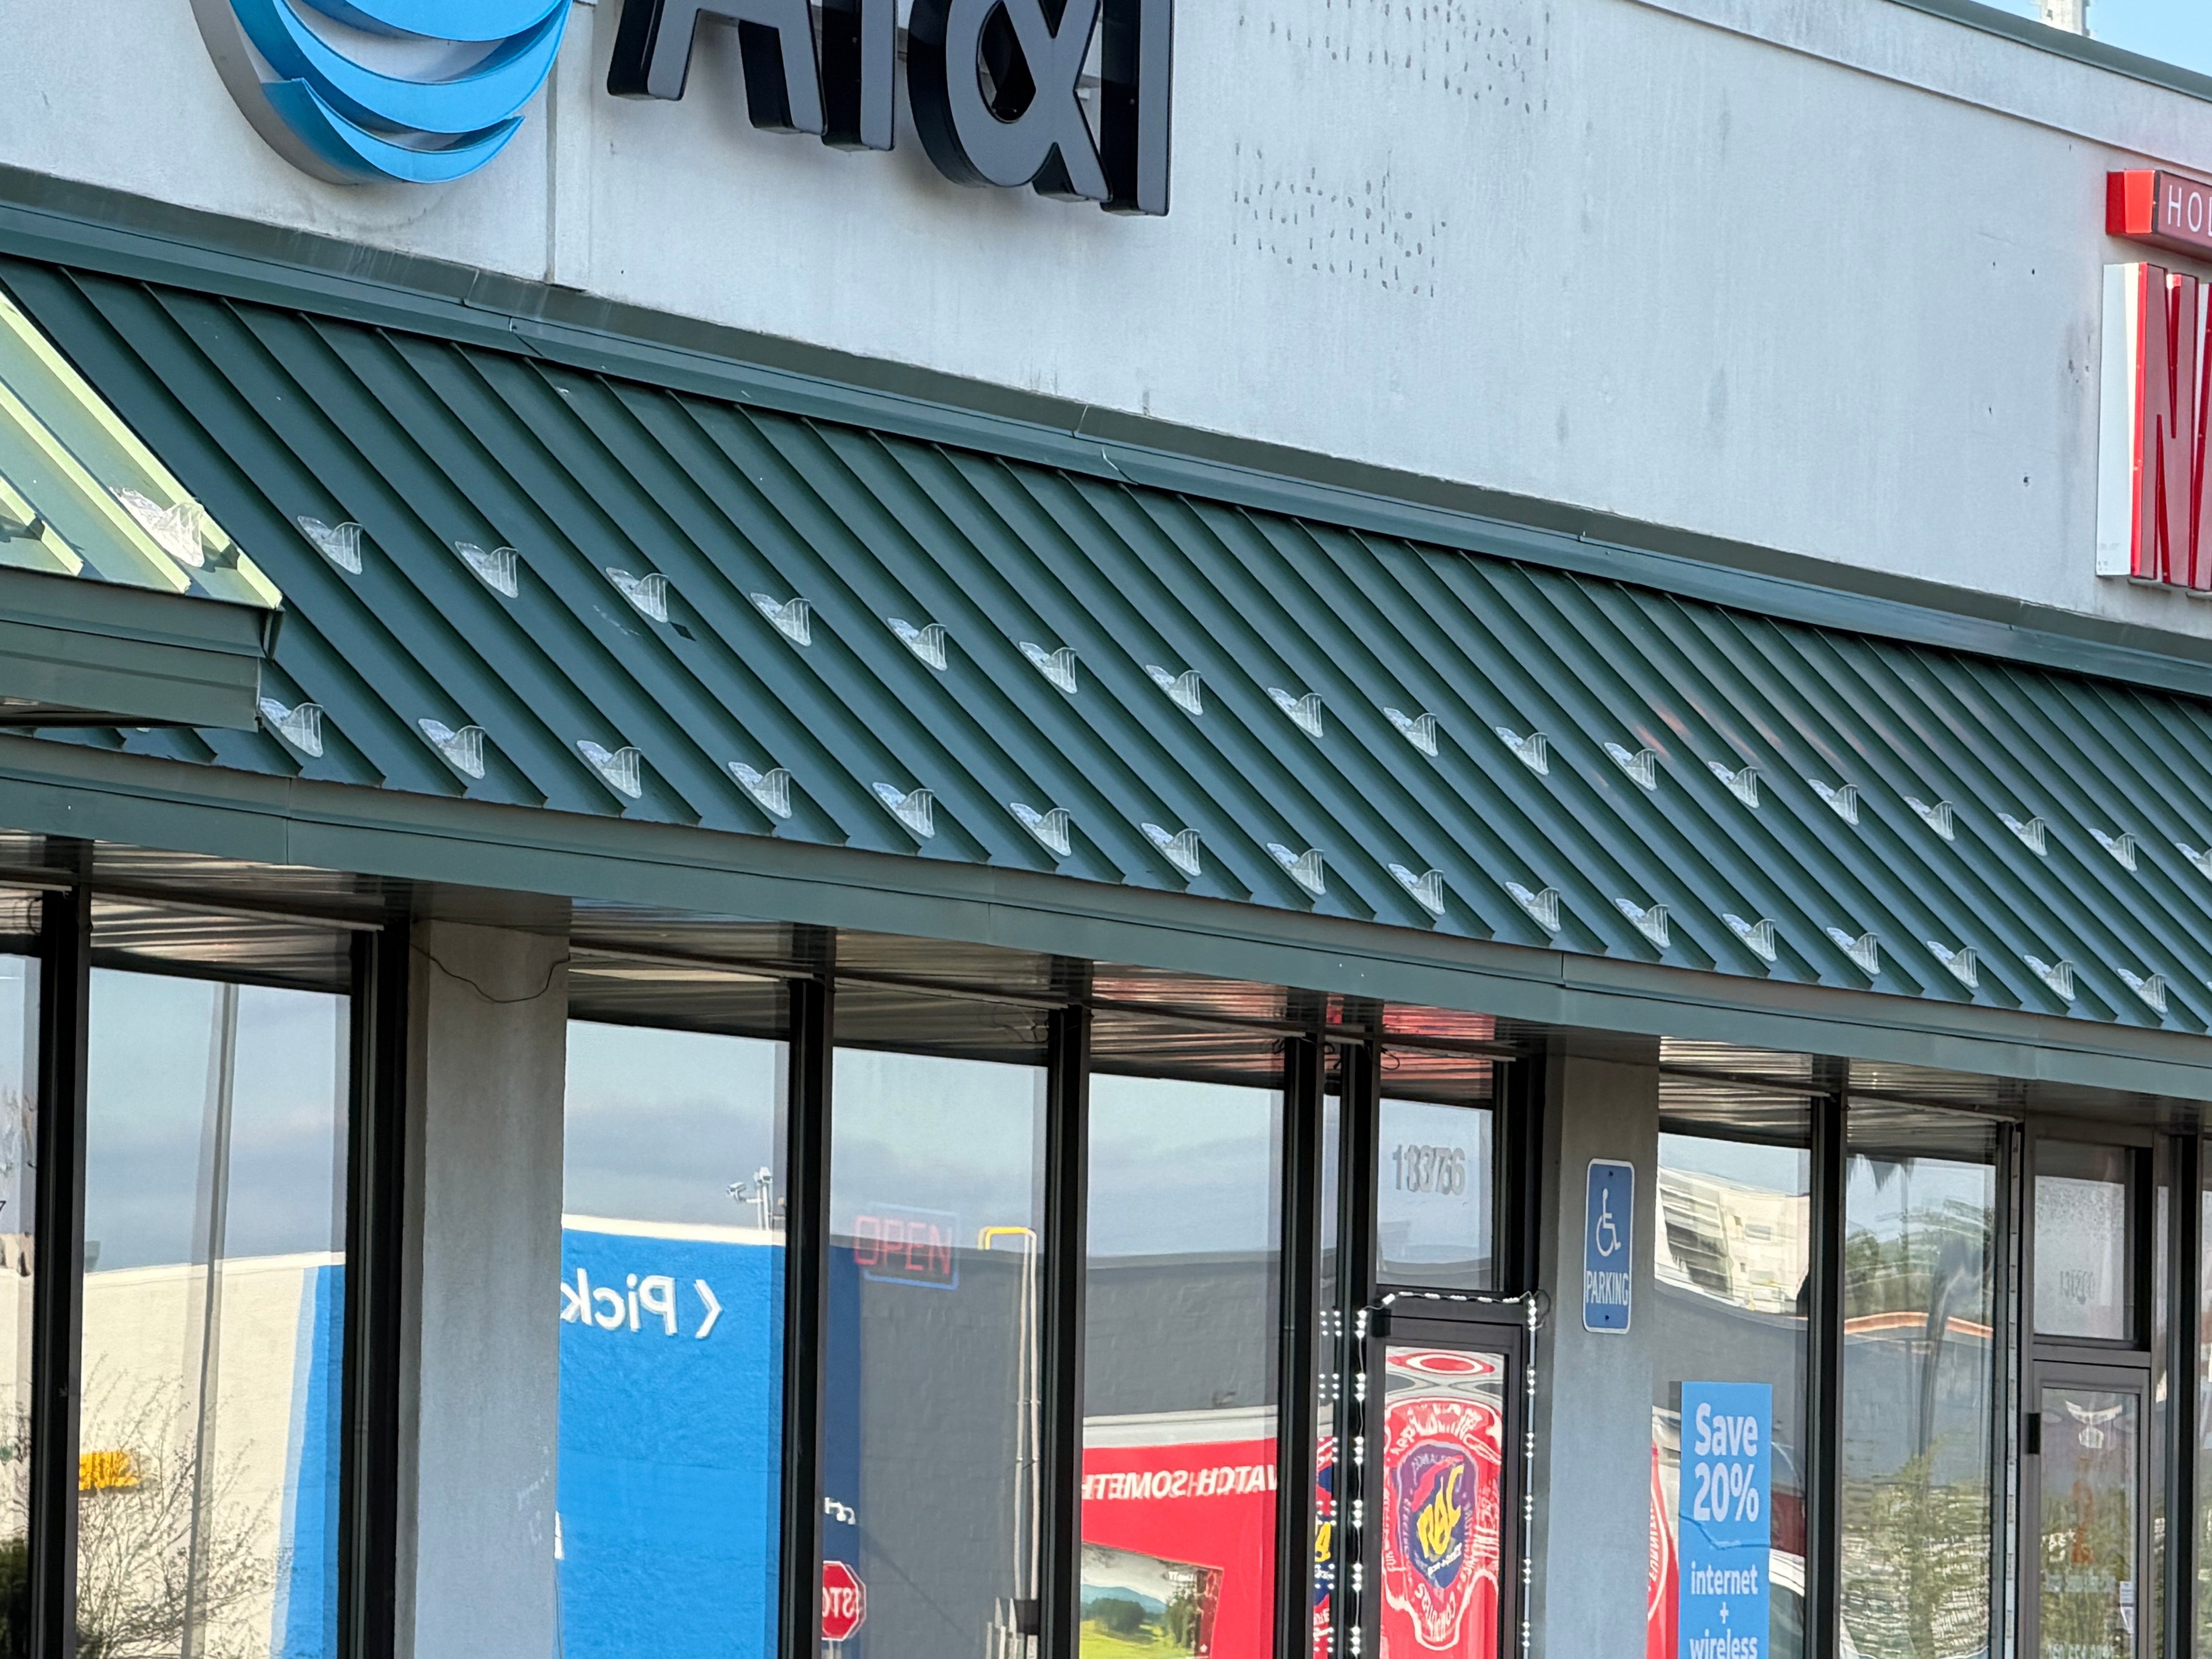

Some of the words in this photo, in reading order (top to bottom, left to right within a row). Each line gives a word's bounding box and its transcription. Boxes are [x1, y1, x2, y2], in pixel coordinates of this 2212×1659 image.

[2126, 262, 2212, 589] N
[854, 1215, 953, 1275] OPEN
[1586, 1271, 1628, 1305] PARKING
[1694, 1402, 1758, 1457] Save
[1693, 1462, 1759, 1522] 20%
[1691, 1561, 1758, 1595] internet
[1689, 1628, 1758, 1659] wireless
